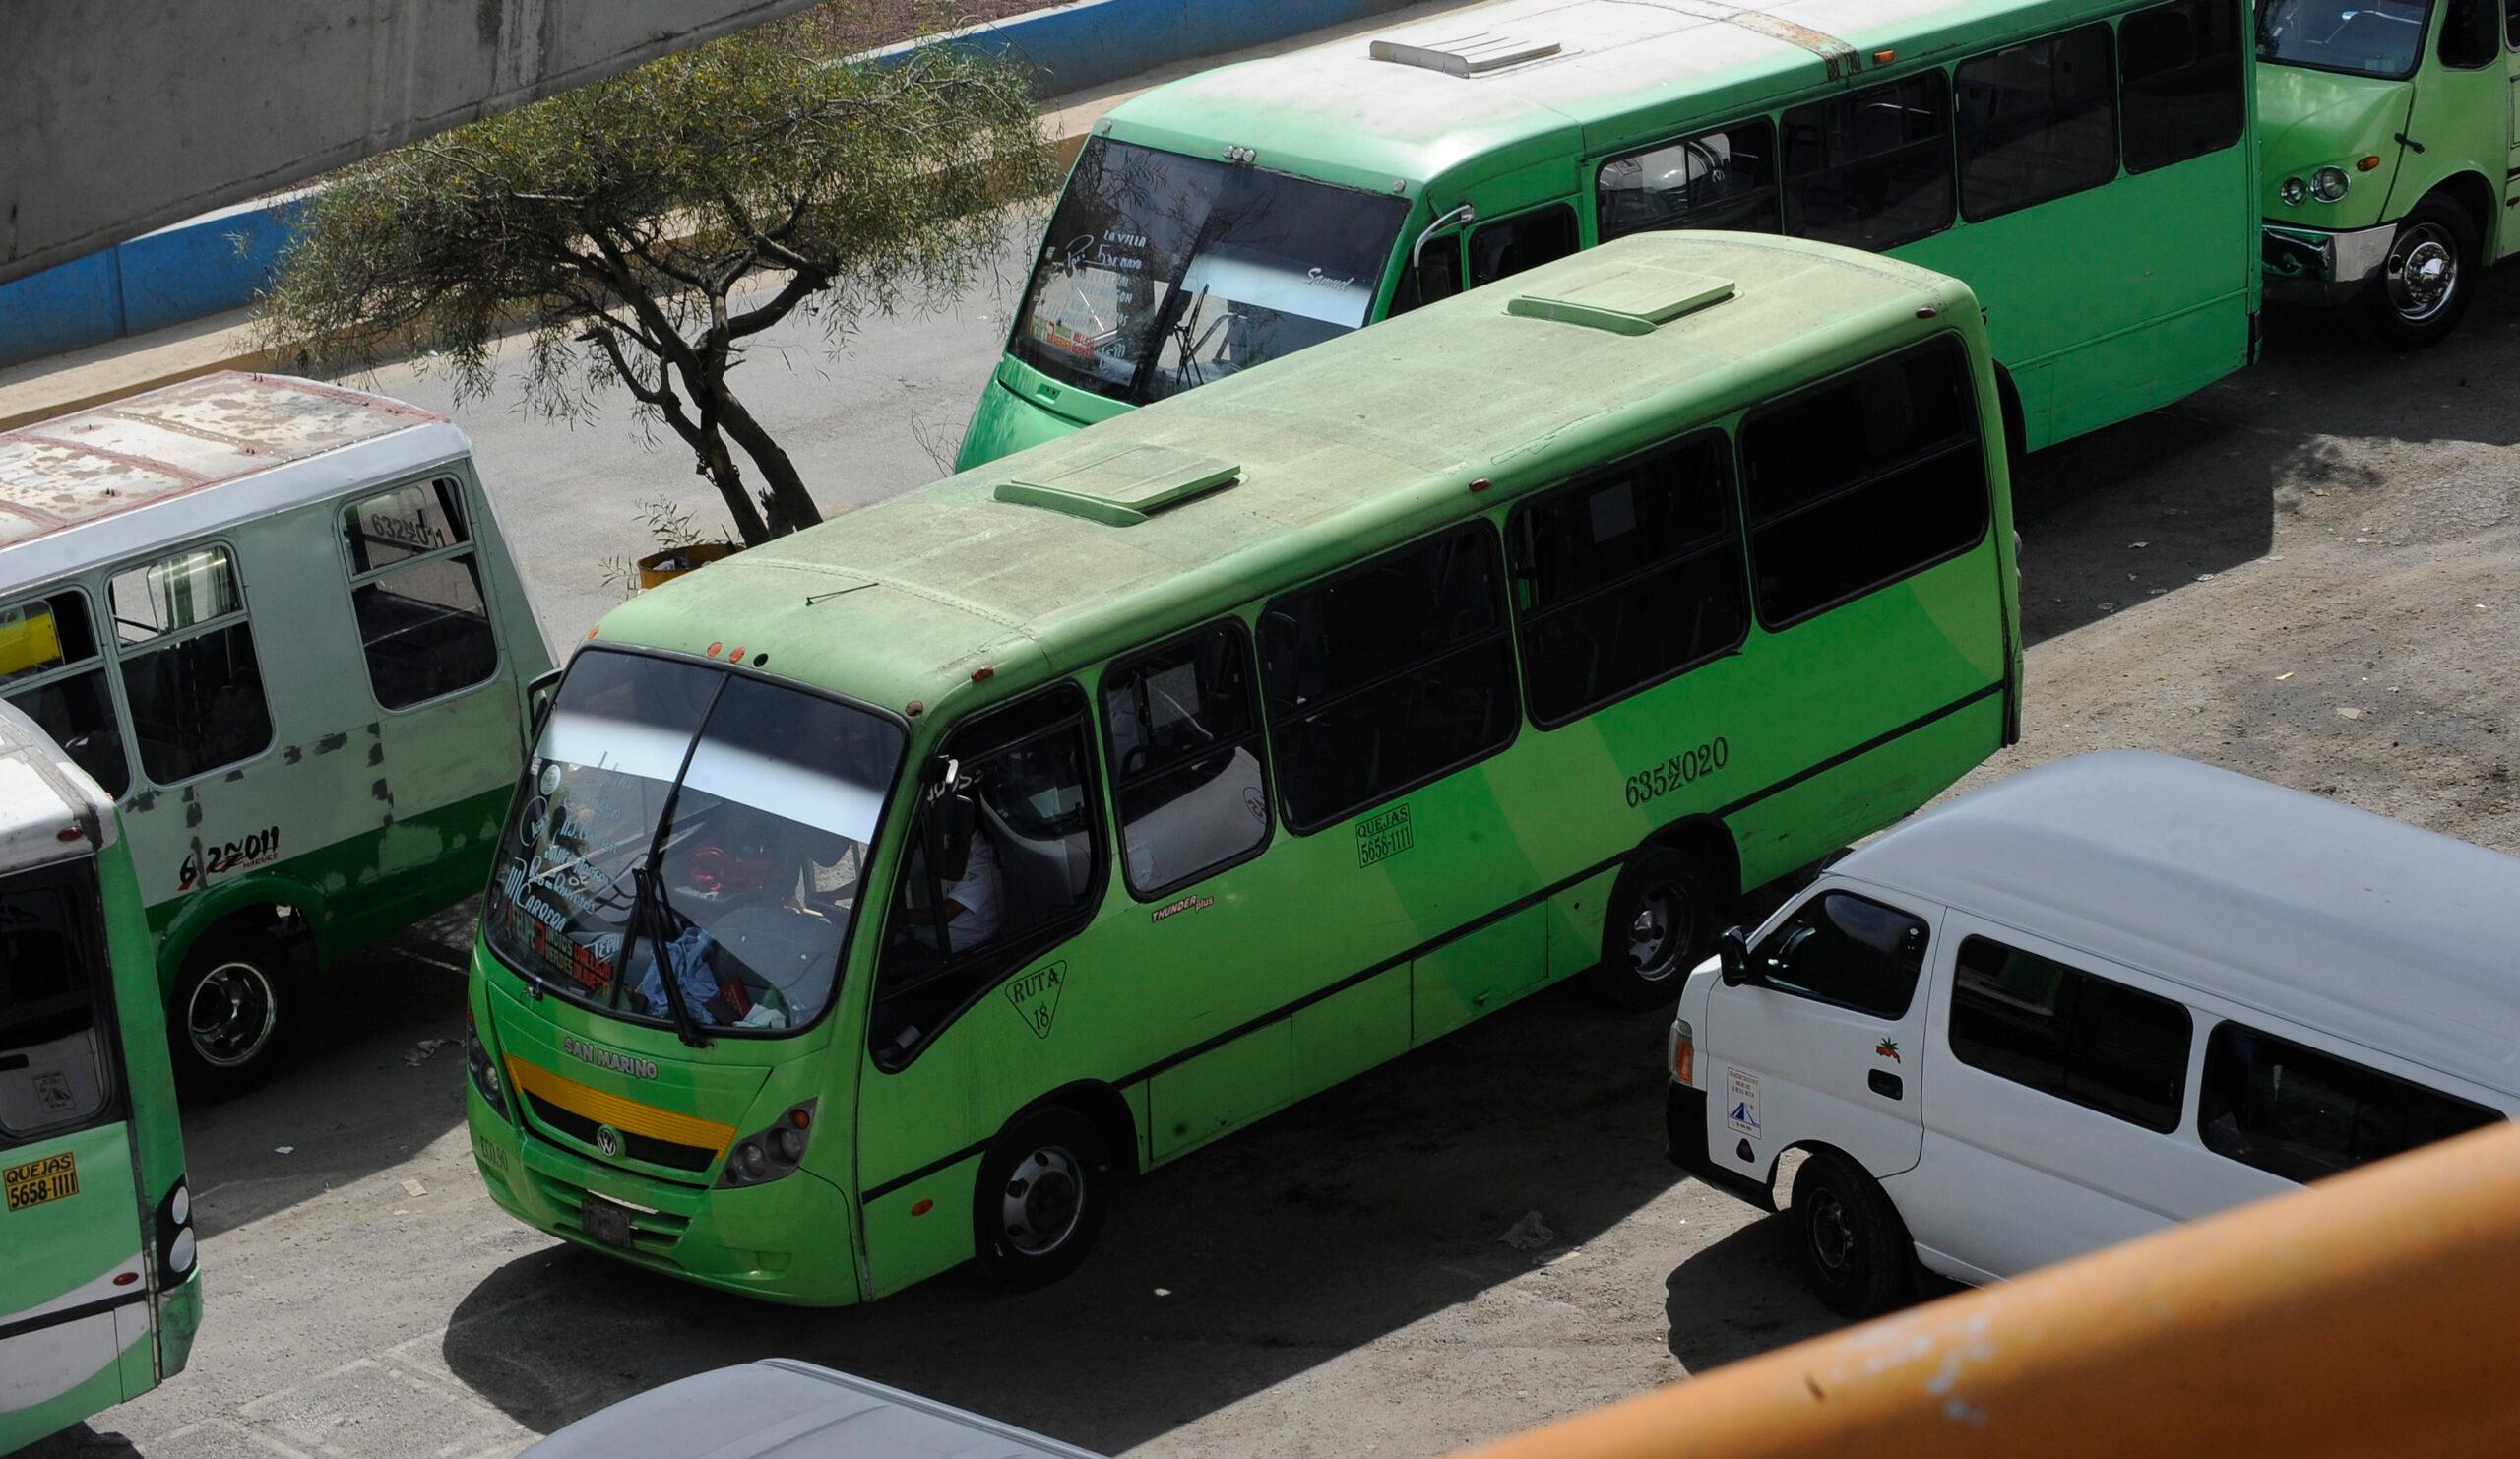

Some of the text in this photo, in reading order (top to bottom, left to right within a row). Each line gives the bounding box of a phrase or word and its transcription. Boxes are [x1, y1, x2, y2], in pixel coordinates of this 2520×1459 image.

[1357, 807, 1408, 838] QUEJAS
[1361, 825, 1412, 864] 5658-1111
[1151, 894, 1214, 923] THUNDER plus
[1012, 967, 1060, 1003] RUTA
[1034, 1001, 1049, 1030] 18
[564, 1036, 659, 1081] SAN MARINO
[6, 1154, 72, 1184] QUEJAS
[10, 1171, 76, 1208] 5658-1111
